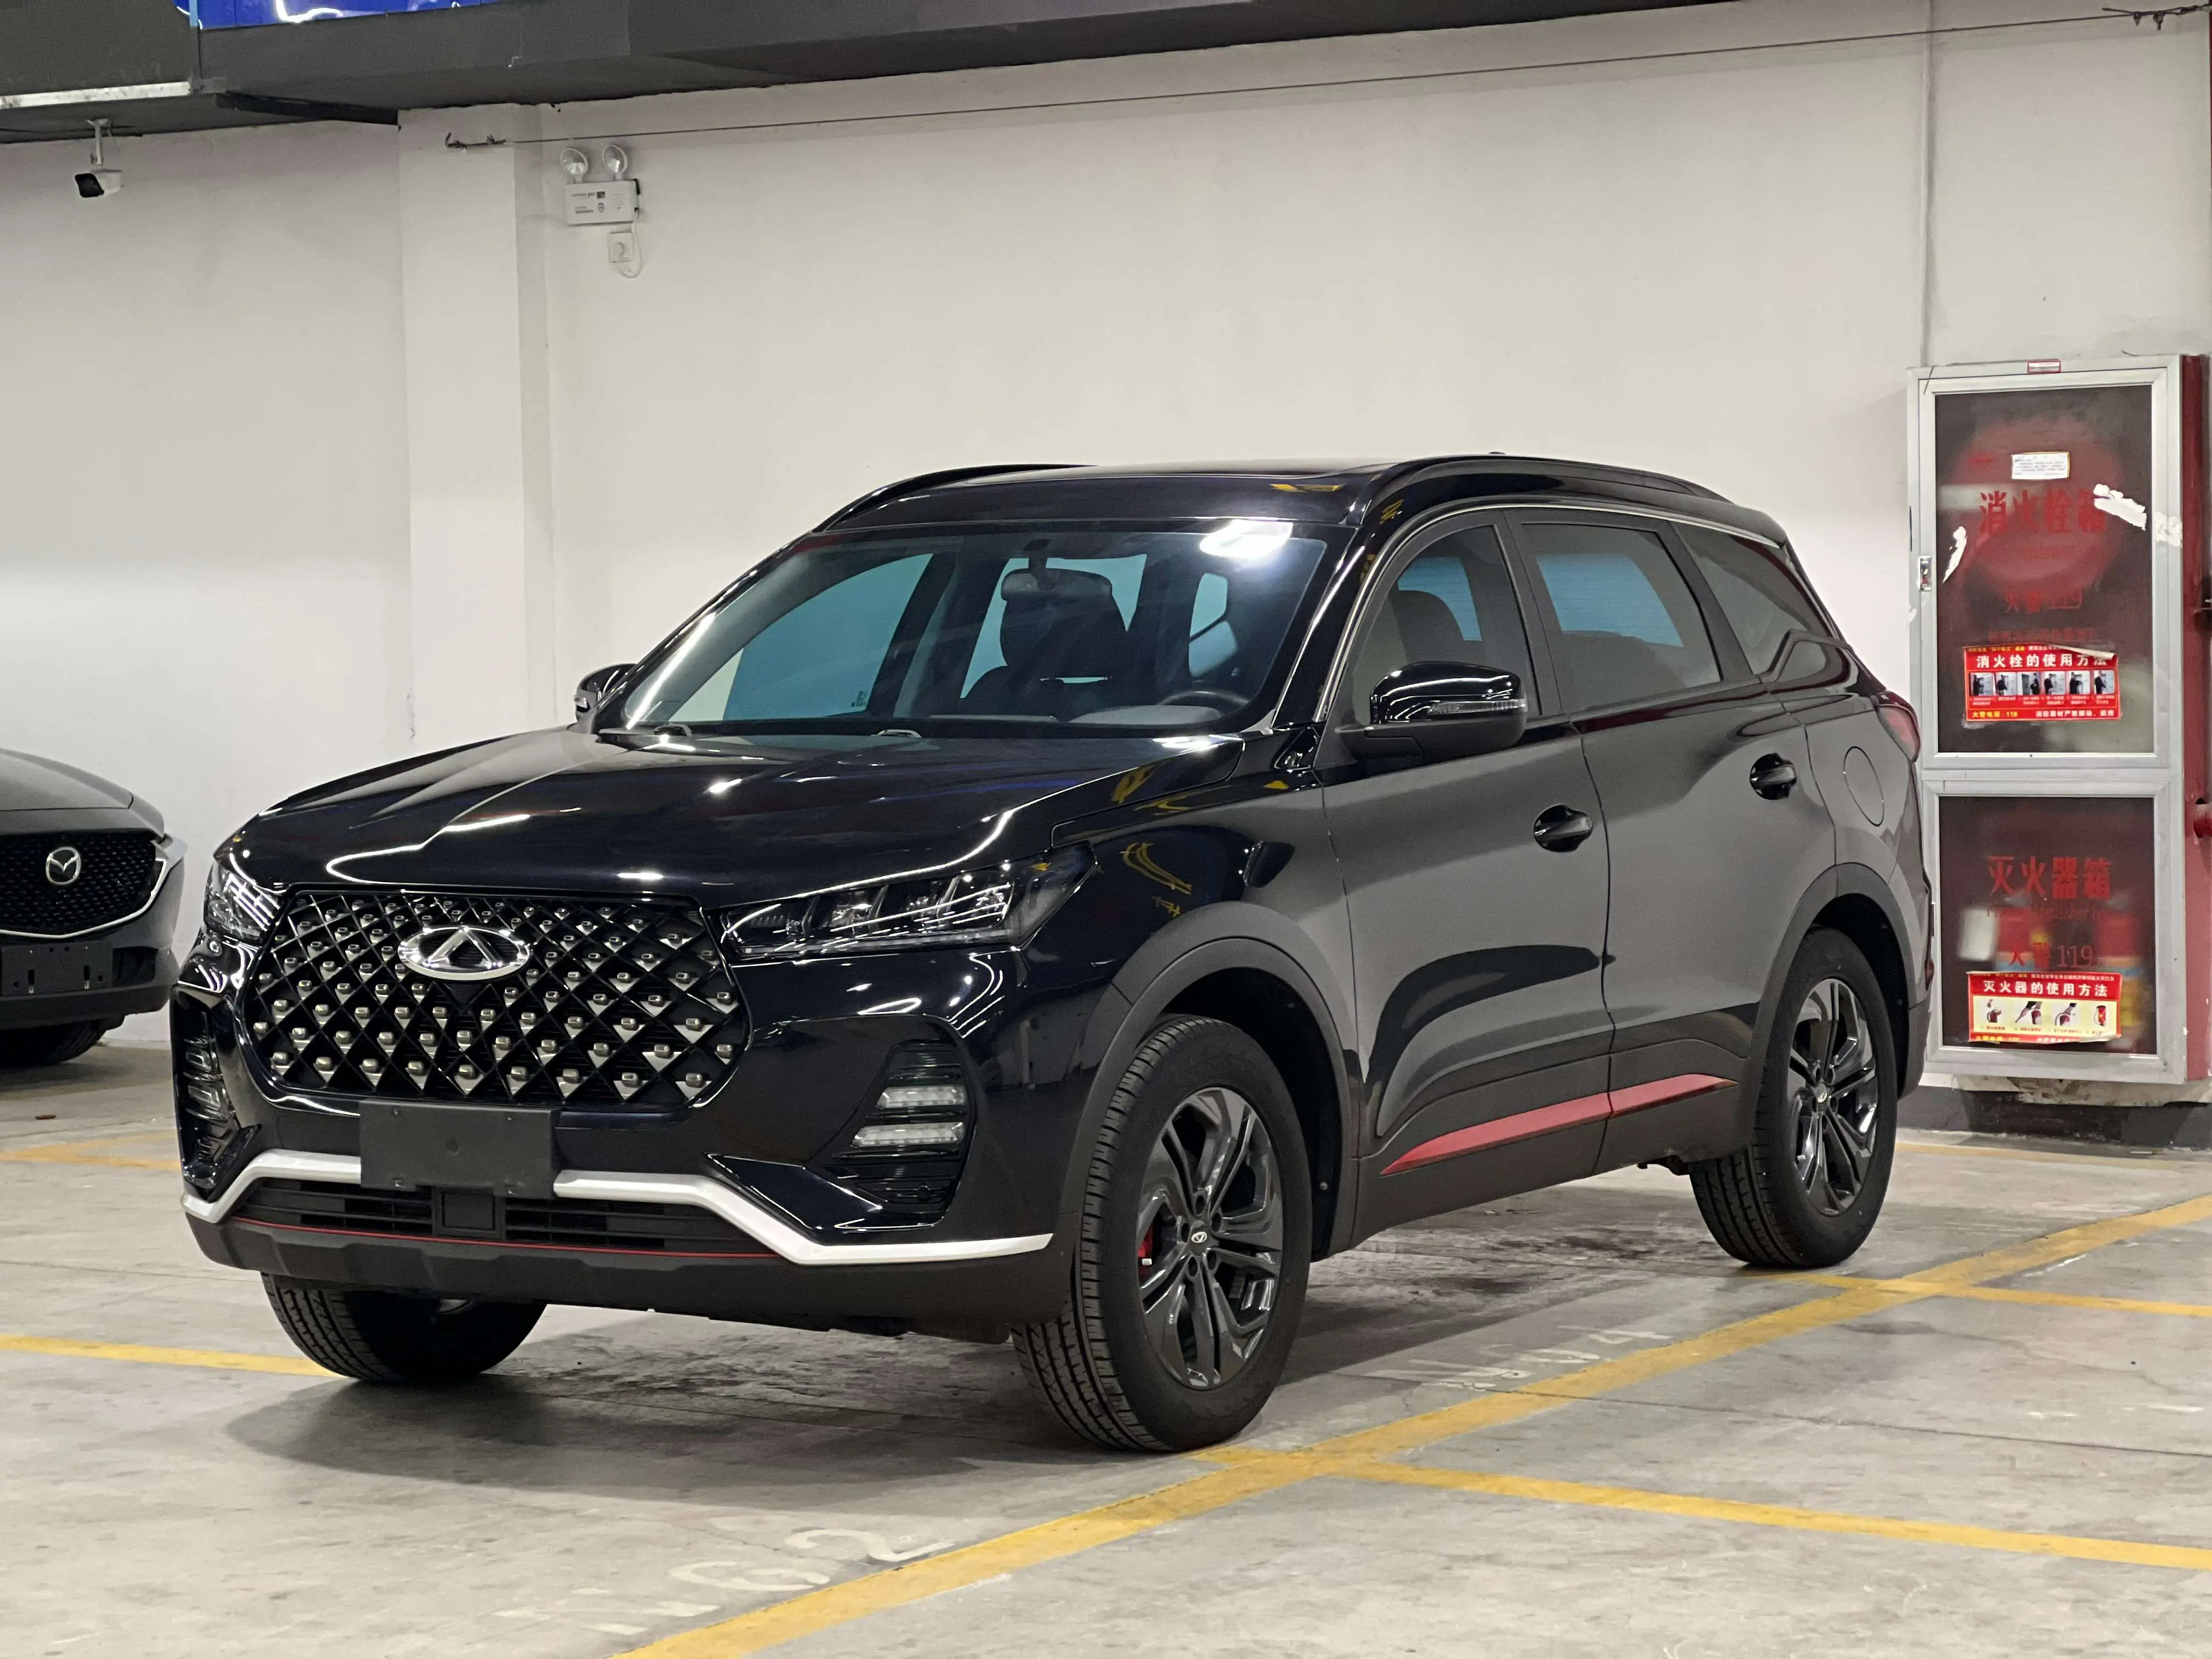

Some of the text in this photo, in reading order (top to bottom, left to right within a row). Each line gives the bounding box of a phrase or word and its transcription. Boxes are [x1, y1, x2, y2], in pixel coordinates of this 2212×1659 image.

[1979, 489, 2106, 534] 消火栓箱
[1976, 653, 2107, 668] 消火栓的使用方法
[1989, 856, 2111, 899] 灭火器箱
[2057, 945, 2094, 968] 119
[1983, 980, 2108, 997] 灭火器的使用方法
